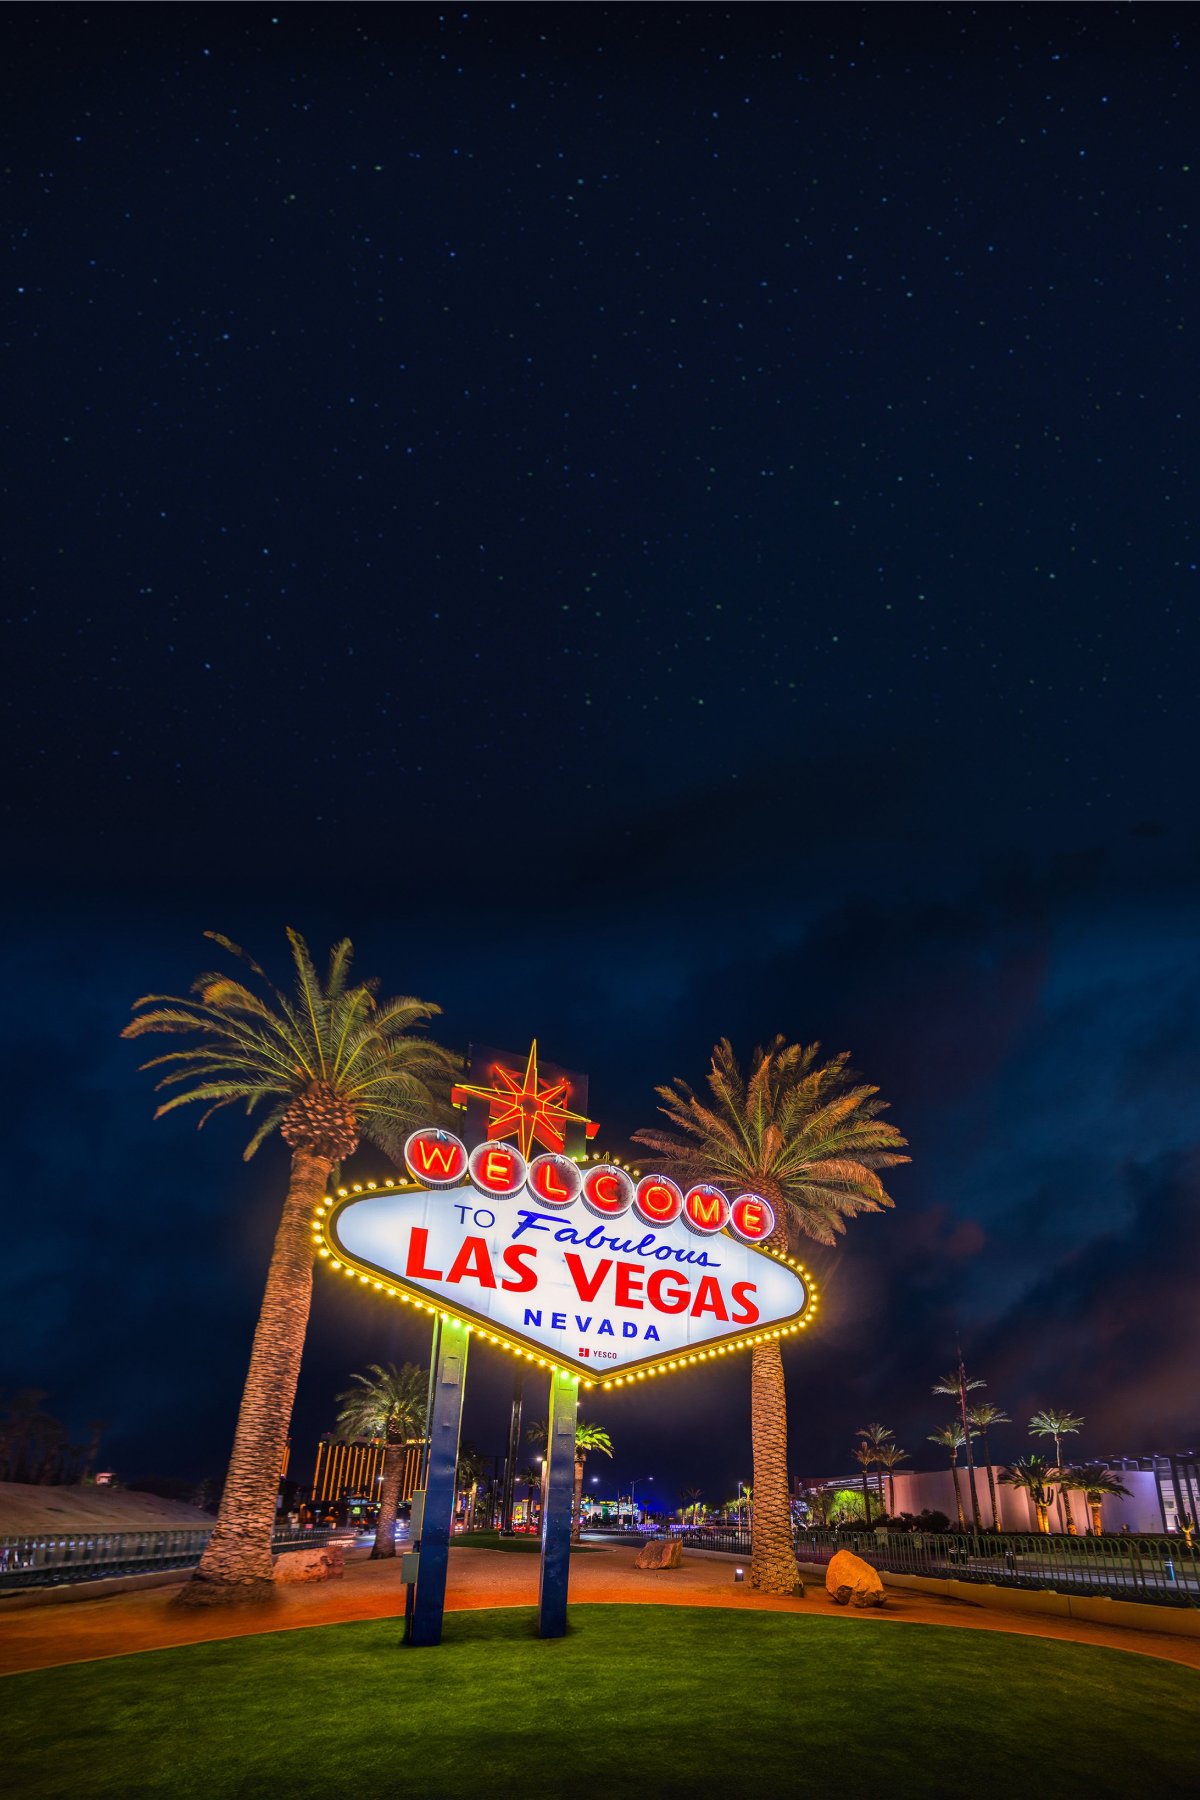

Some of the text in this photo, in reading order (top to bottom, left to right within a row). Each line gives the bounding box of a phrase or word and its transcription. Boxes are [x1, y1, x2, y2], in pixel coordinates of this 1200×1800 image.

[418, 1139, 763, 1233] WELCOME
[454, 1204, 496, 1229] TO
[511, 1209, 722, 1268] Fabulous
[405, 1226, 760, 1325] LAS VEGAS
[523, 1308, 661, 1342] NEVADA
[593, 1350, 618, 1360] YESCO
